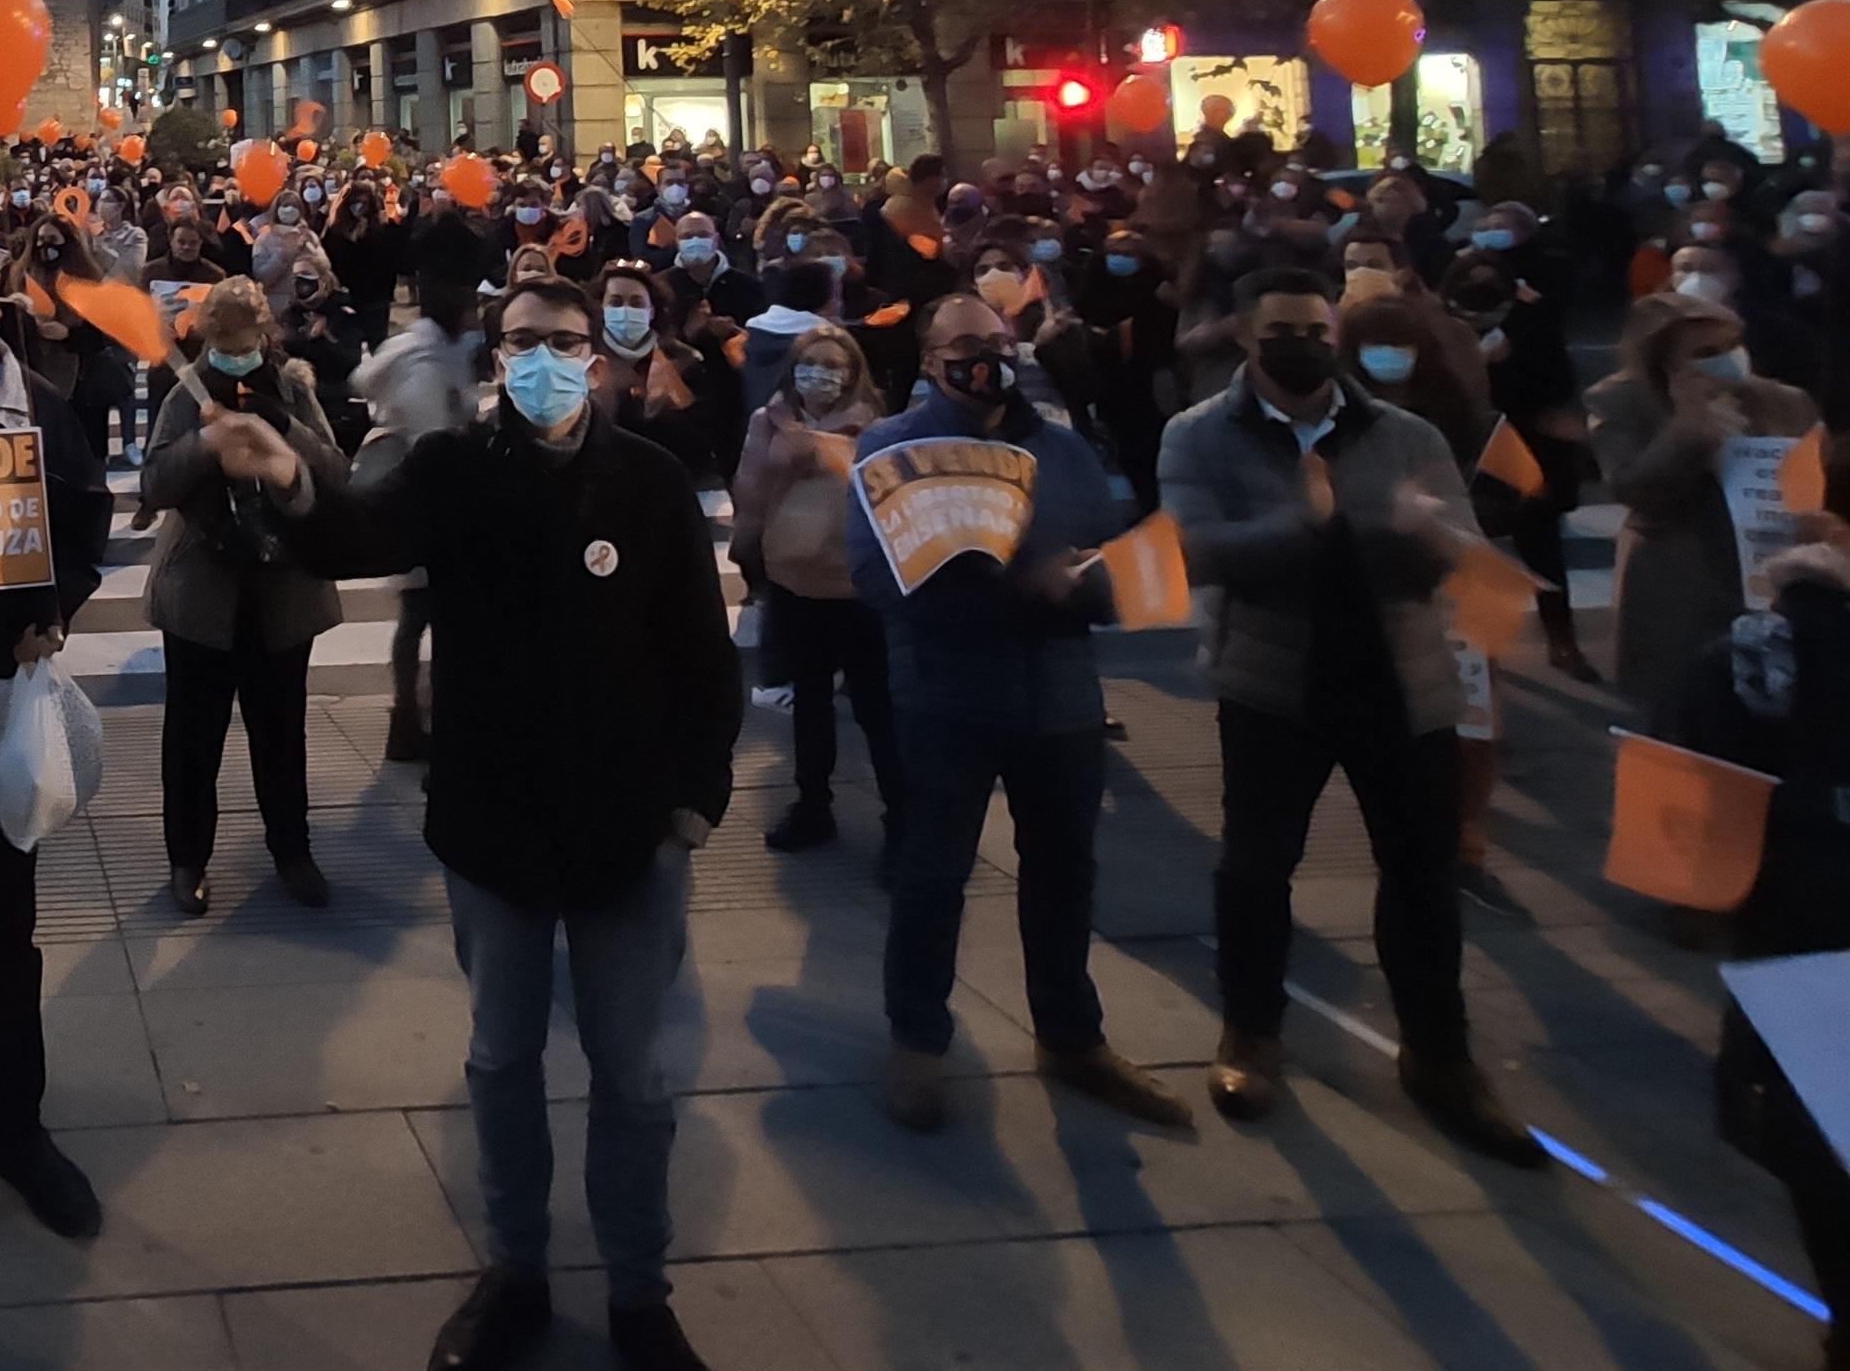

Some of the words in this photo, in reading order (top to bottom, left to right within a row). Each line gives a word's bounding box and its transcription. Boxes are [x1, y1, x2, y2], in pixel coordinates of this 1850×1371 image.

[637, 39, 659, 69] k
[1006, 37, 1026, 65] k
[10, 497, 39, 521] DE
